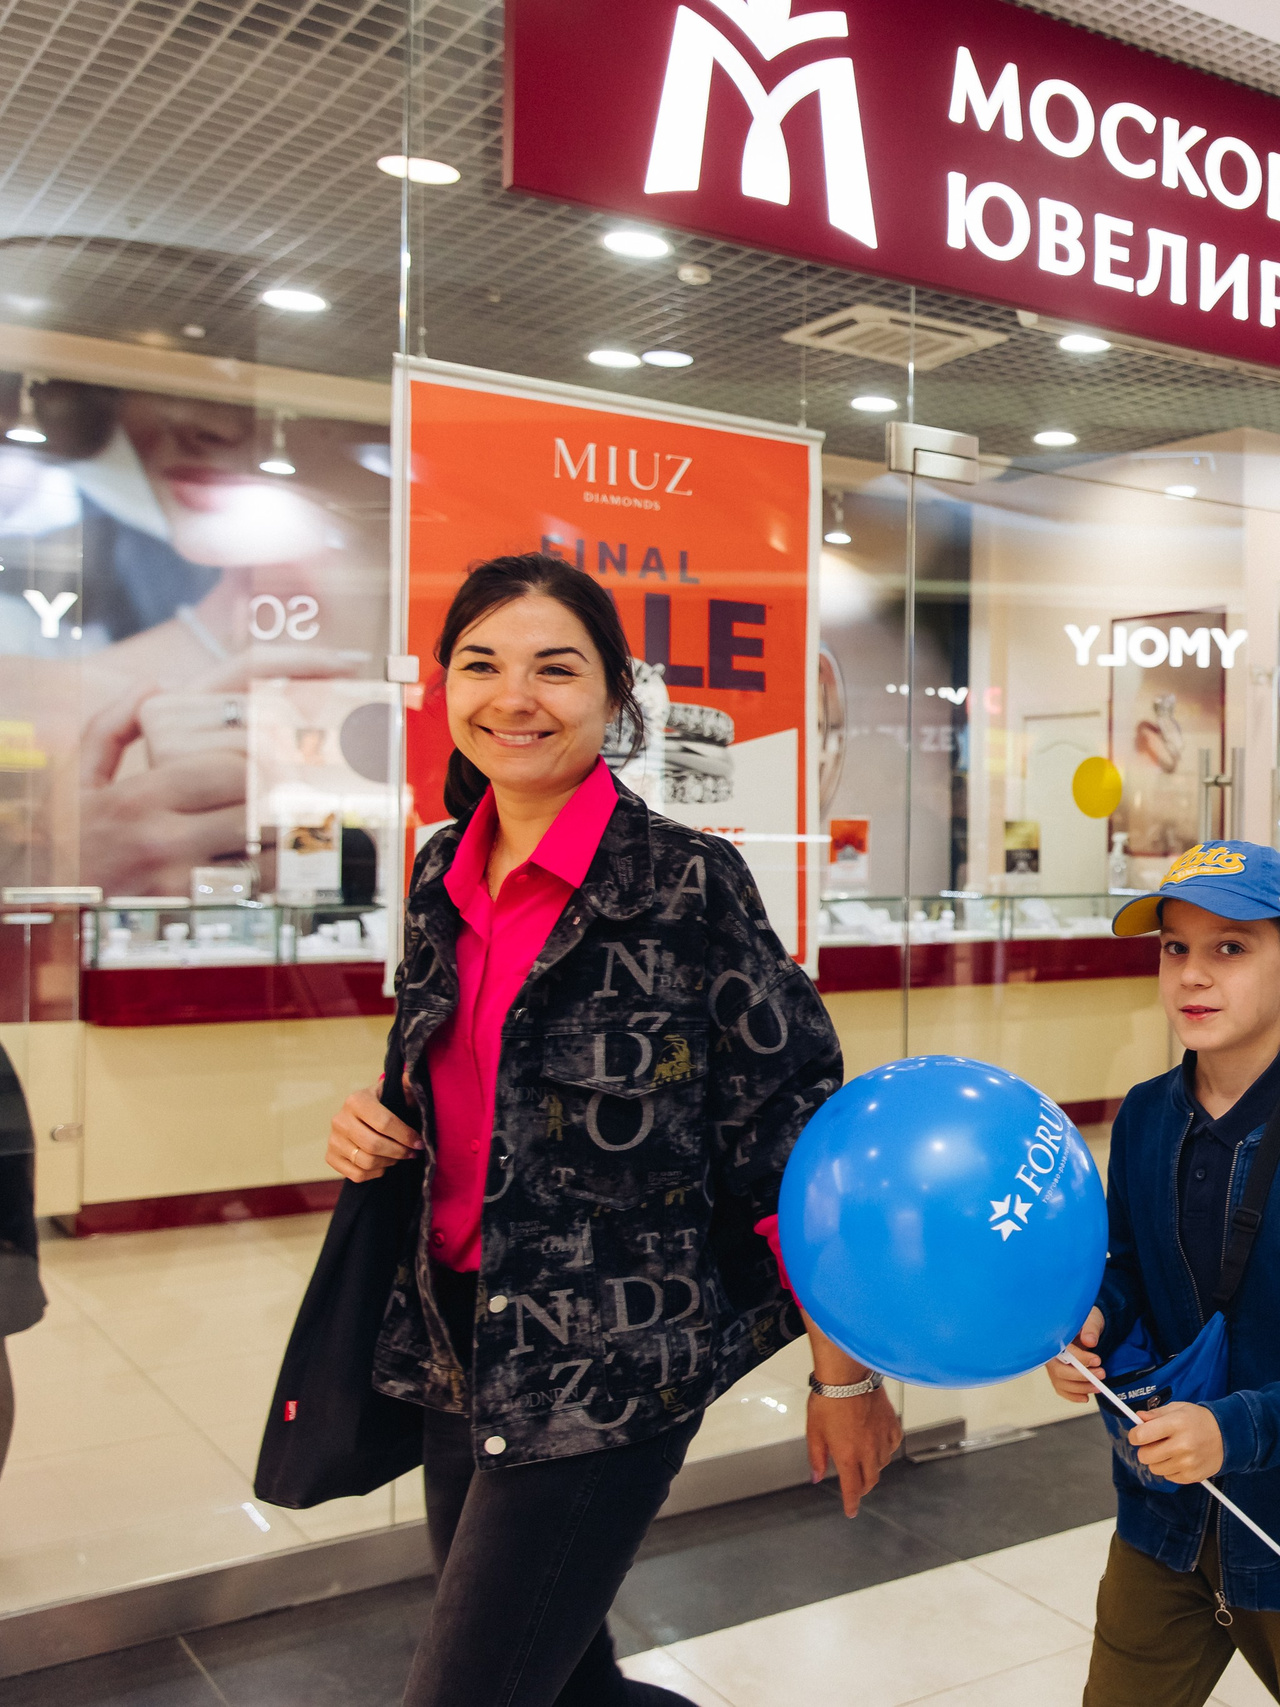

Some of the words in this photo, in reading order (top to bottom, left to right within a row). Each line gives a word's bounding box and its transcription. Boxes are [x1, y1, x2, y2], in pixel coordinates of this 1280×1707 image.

[554, 437, 693, 496] MIUZ
[583, 491, 661, 511] DIAMONDS
[1128, 1385, 1157, 1399] ANGELES
